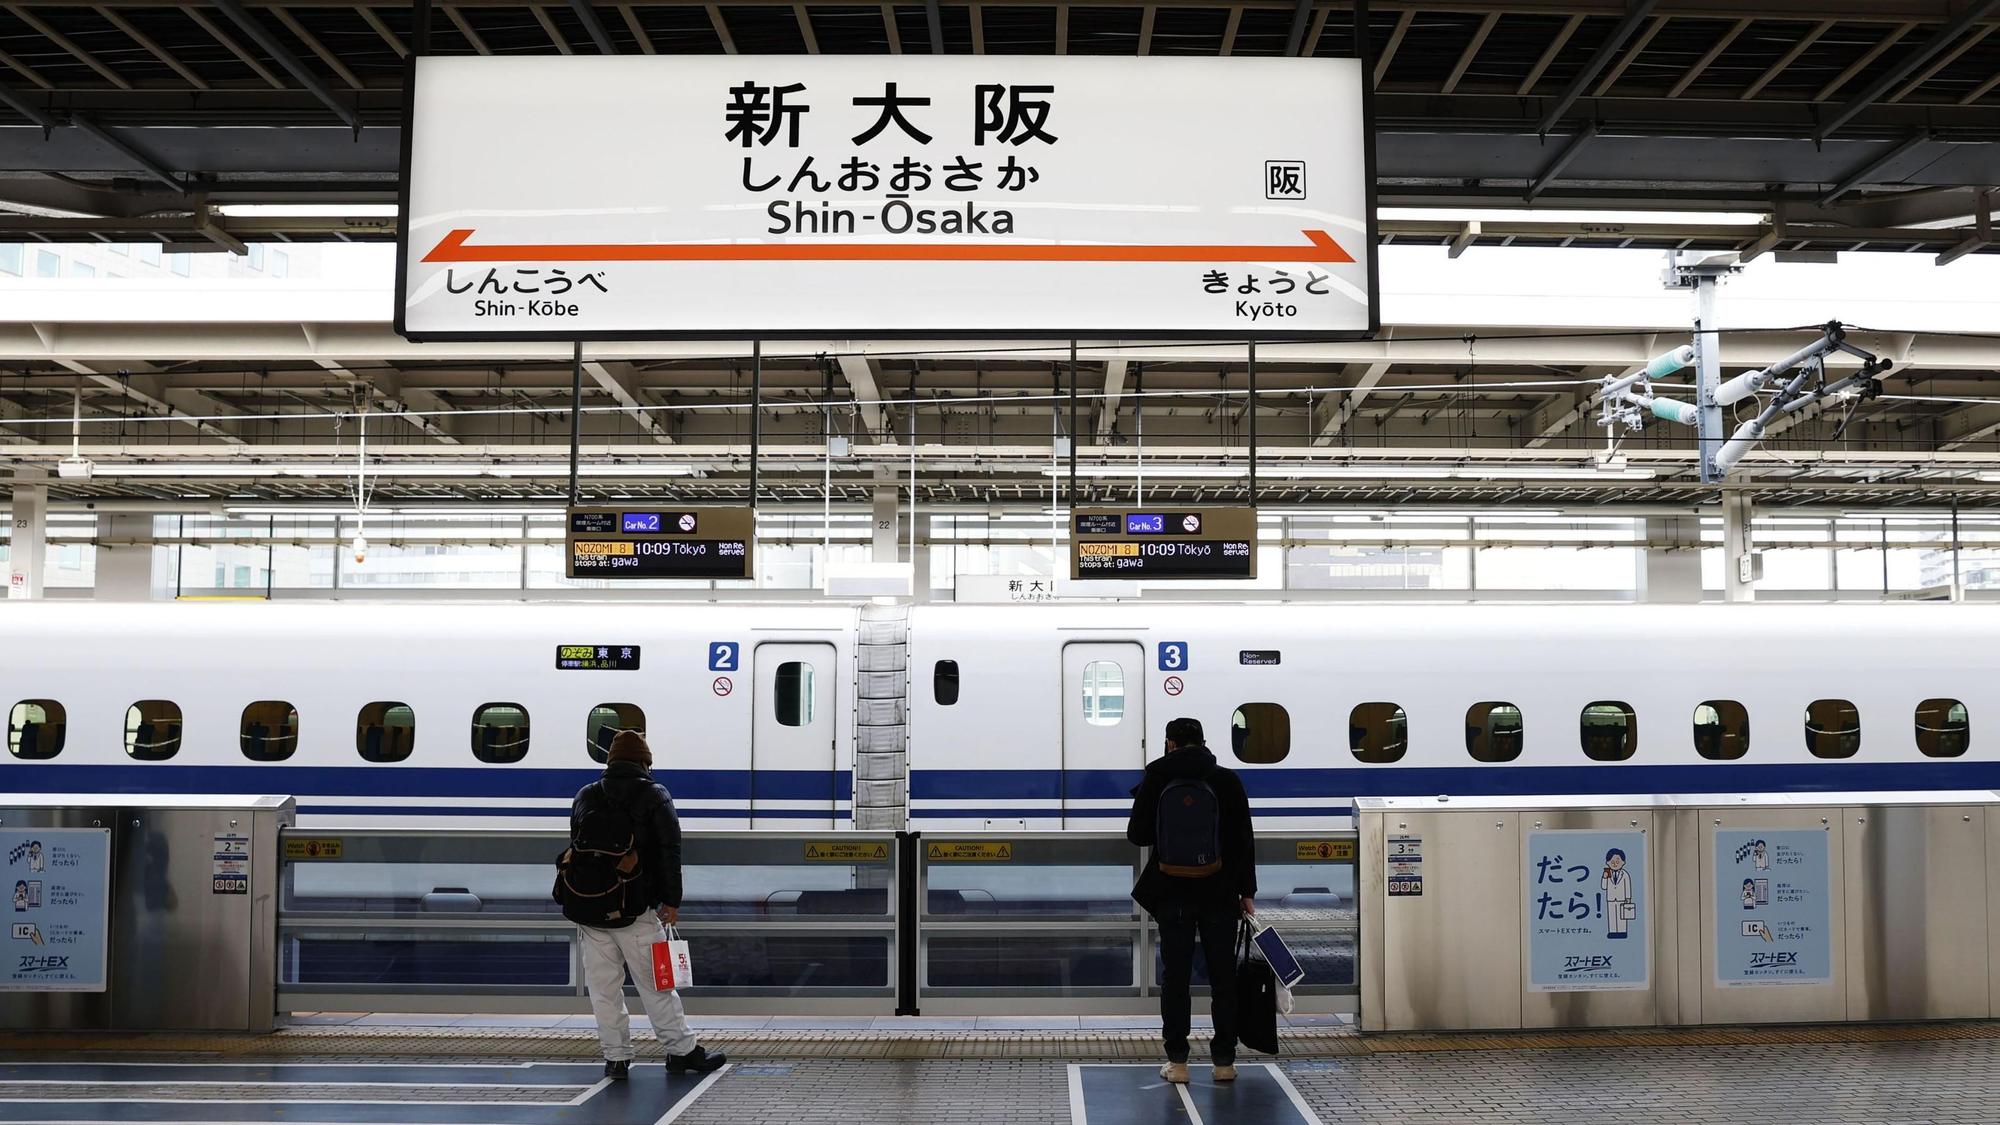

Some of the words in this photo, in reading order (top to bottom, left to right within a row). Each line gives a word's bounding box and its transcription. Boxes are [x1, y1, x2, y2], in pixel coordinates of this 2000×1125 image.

[725, 81, 1058, 147] 新大阪
[743, 155, 1039, 192] しんおおさか
[1270, 166, 1302, 194] 阪
[767, 194, 1014, 234] Shin-Ōsaka
[446, 268, 608, 295] しんこうべ
[1202, 269, 1330, 295] きょうと
[475, 300, 579, 316] Shin-Kōbe
[1236, 301, 1297, 321] Kyōto
[16, 520, 27, 528] 23
[648, 516, 658, 530] 2
[879, 521, 890, 529] 22
[1152, 517, 1162, 531] 3
[576, 544, 613, 553] NOZOMI
[635, 543, 671, 555] 10:09
[672, 543, 706, 556] Tōkyō
[1080, 545, 1117, 555] NOZOMI
[1140, 544, 1175, 556] 10:09
[1177, 543, 1211, 557] Tōkyō
[611, 557, 639, 568] gawa
[1116, 558, 1143, 569] gawa
[1009, 580, 1053, 592] 新大
[561, 647, 593, 658] のぞみ
[597, 647, 632, 659] 東京
[715, 646, 731, 668] 2
[1165, 645, 1181, 668] 3
[224, 842, 231, 852] 2
[1398, 844, 1405, 853] 3
[1536, 855, 1590, 884] だっ
[1537, 891, 1602, 920] たら!
[18, 926, 29, 935] IC
[1747, 924, 1758, 933] IC
[19, 956, 69, 967] スマートEX
[1564, 955, 1613, 967] スマートEX
[1750, 952, 1798, 963] スマートEX
